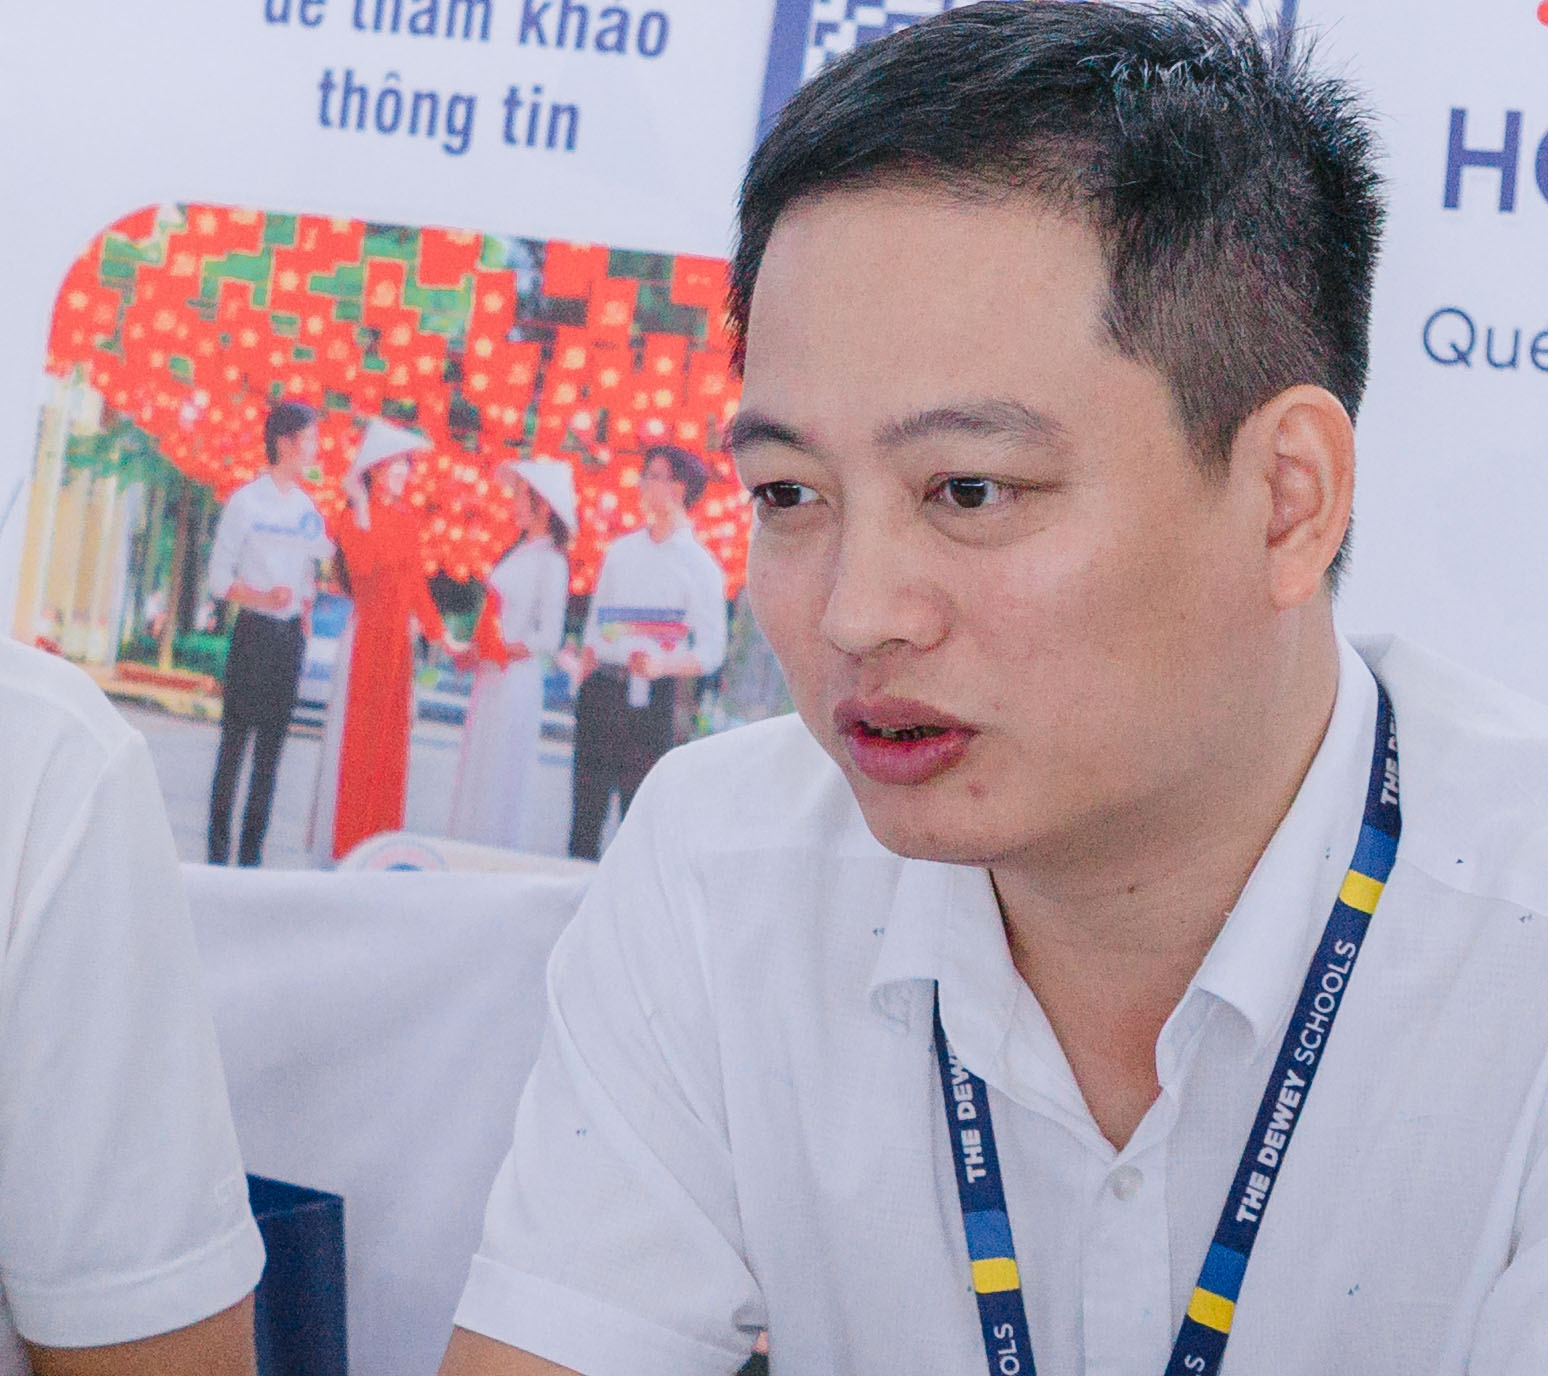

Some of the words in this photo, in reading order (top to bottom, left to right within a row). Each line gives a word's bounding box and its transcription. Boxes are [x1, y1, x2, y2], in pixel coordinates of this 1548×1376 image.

[317, 68, 477, 157] thông
[502, 82, 582, 154] tin
[948, 1055, 977, 1121] DEW
[1235, 1171, 1272, 1224] THE
[1257, 1069, 1306, 1167] DEWEY
[1293, 937, 1357, 1067] SCHOOLS
[960, 1128, 987, 1184] THE
